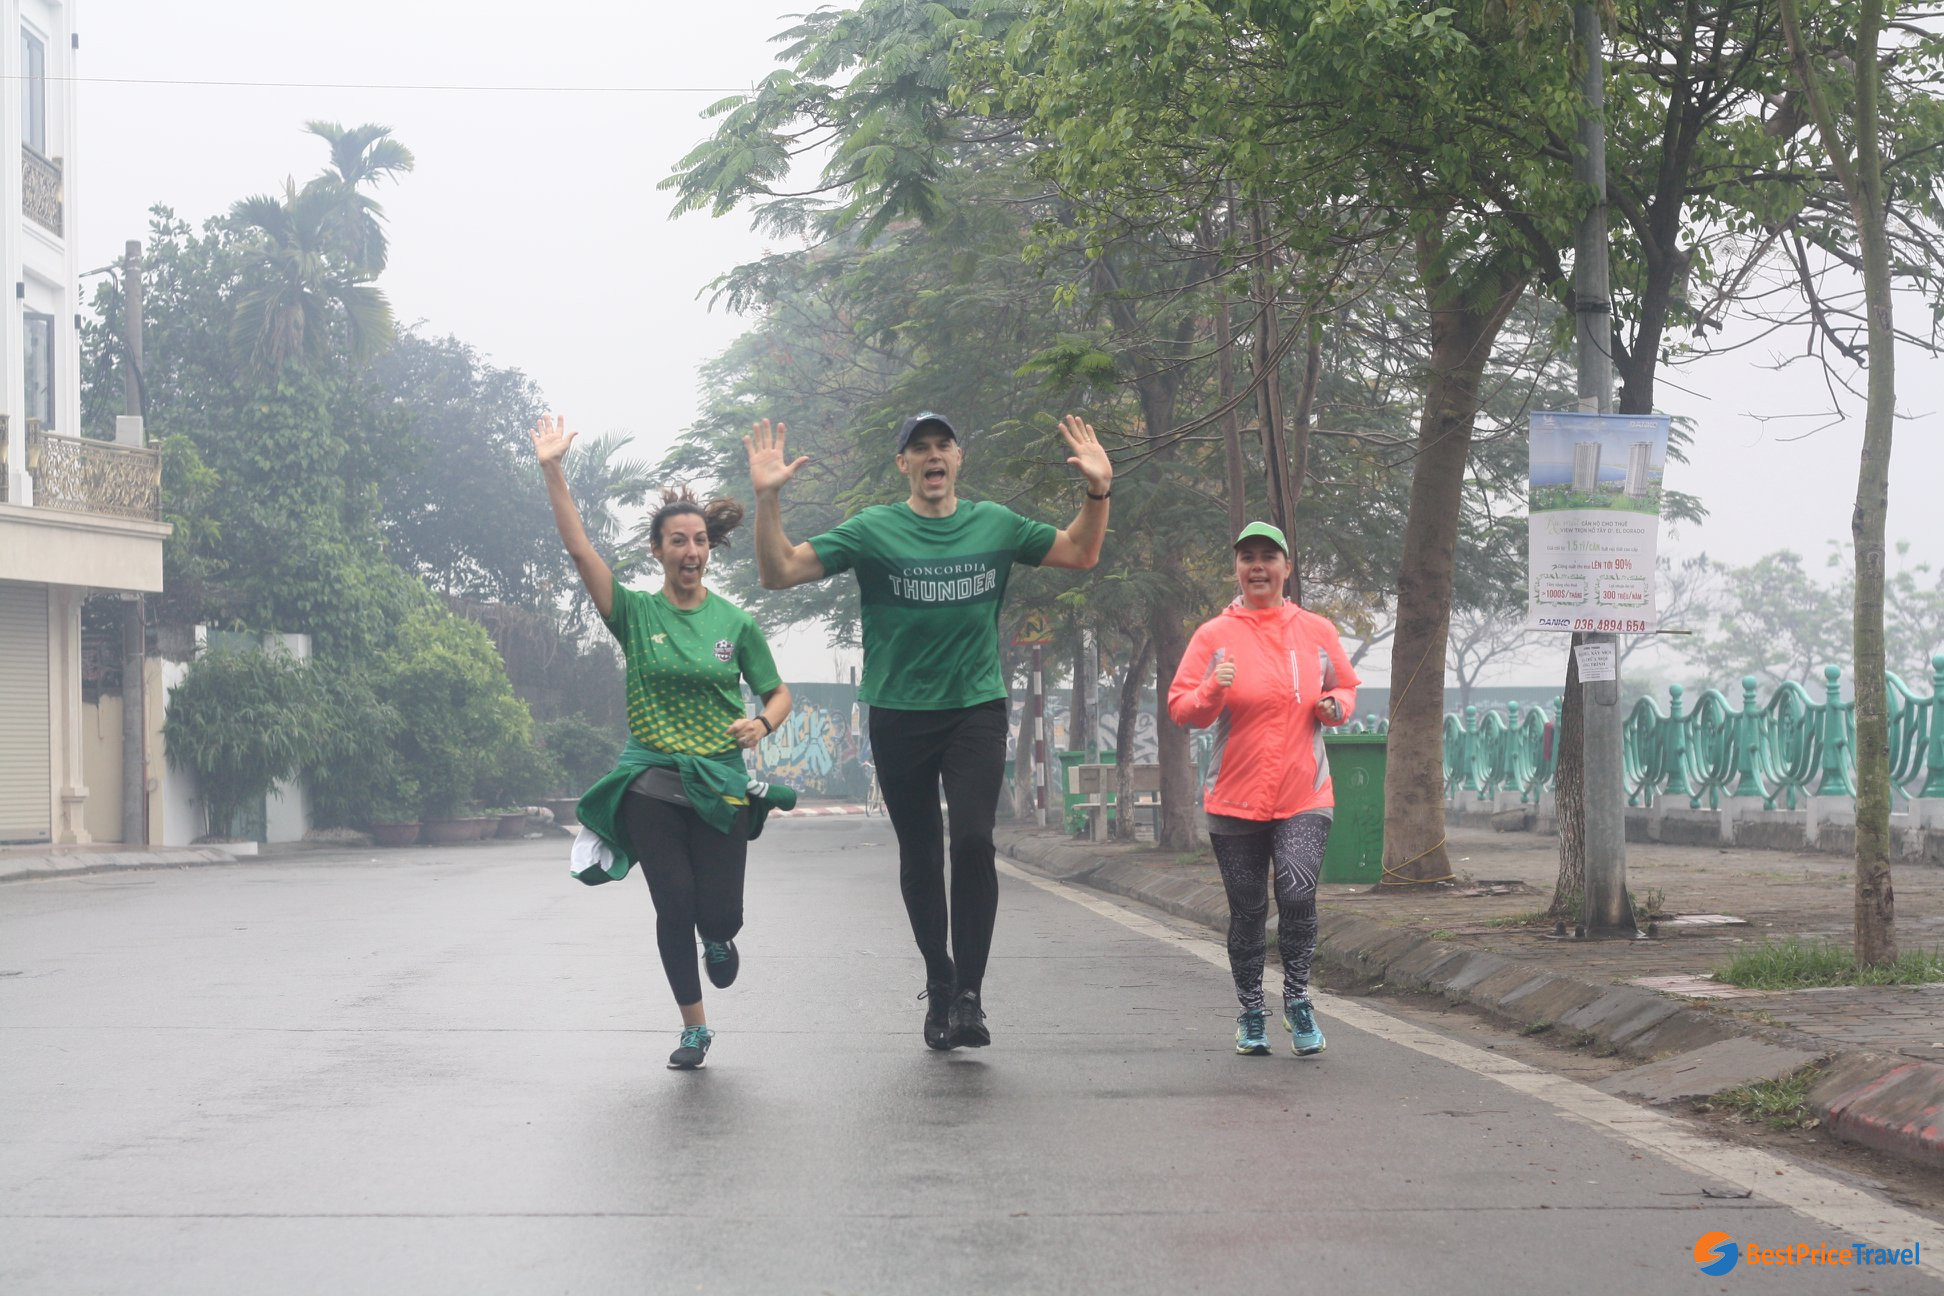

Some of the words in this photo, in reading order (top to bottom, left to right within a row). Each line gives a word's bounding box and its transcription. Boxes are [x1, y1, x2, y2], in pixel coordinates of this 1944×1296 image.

[903, 563, 986, 577] CONCORDIA
[1591, 561, 1602, 570] LÊN
[1615, 559, 1632, 570] 90%
[888, 569, 996, 602] THUNDER
[1602, 590, 1616, 600] 300
[1539, 618, 1571, 627] DANKO
